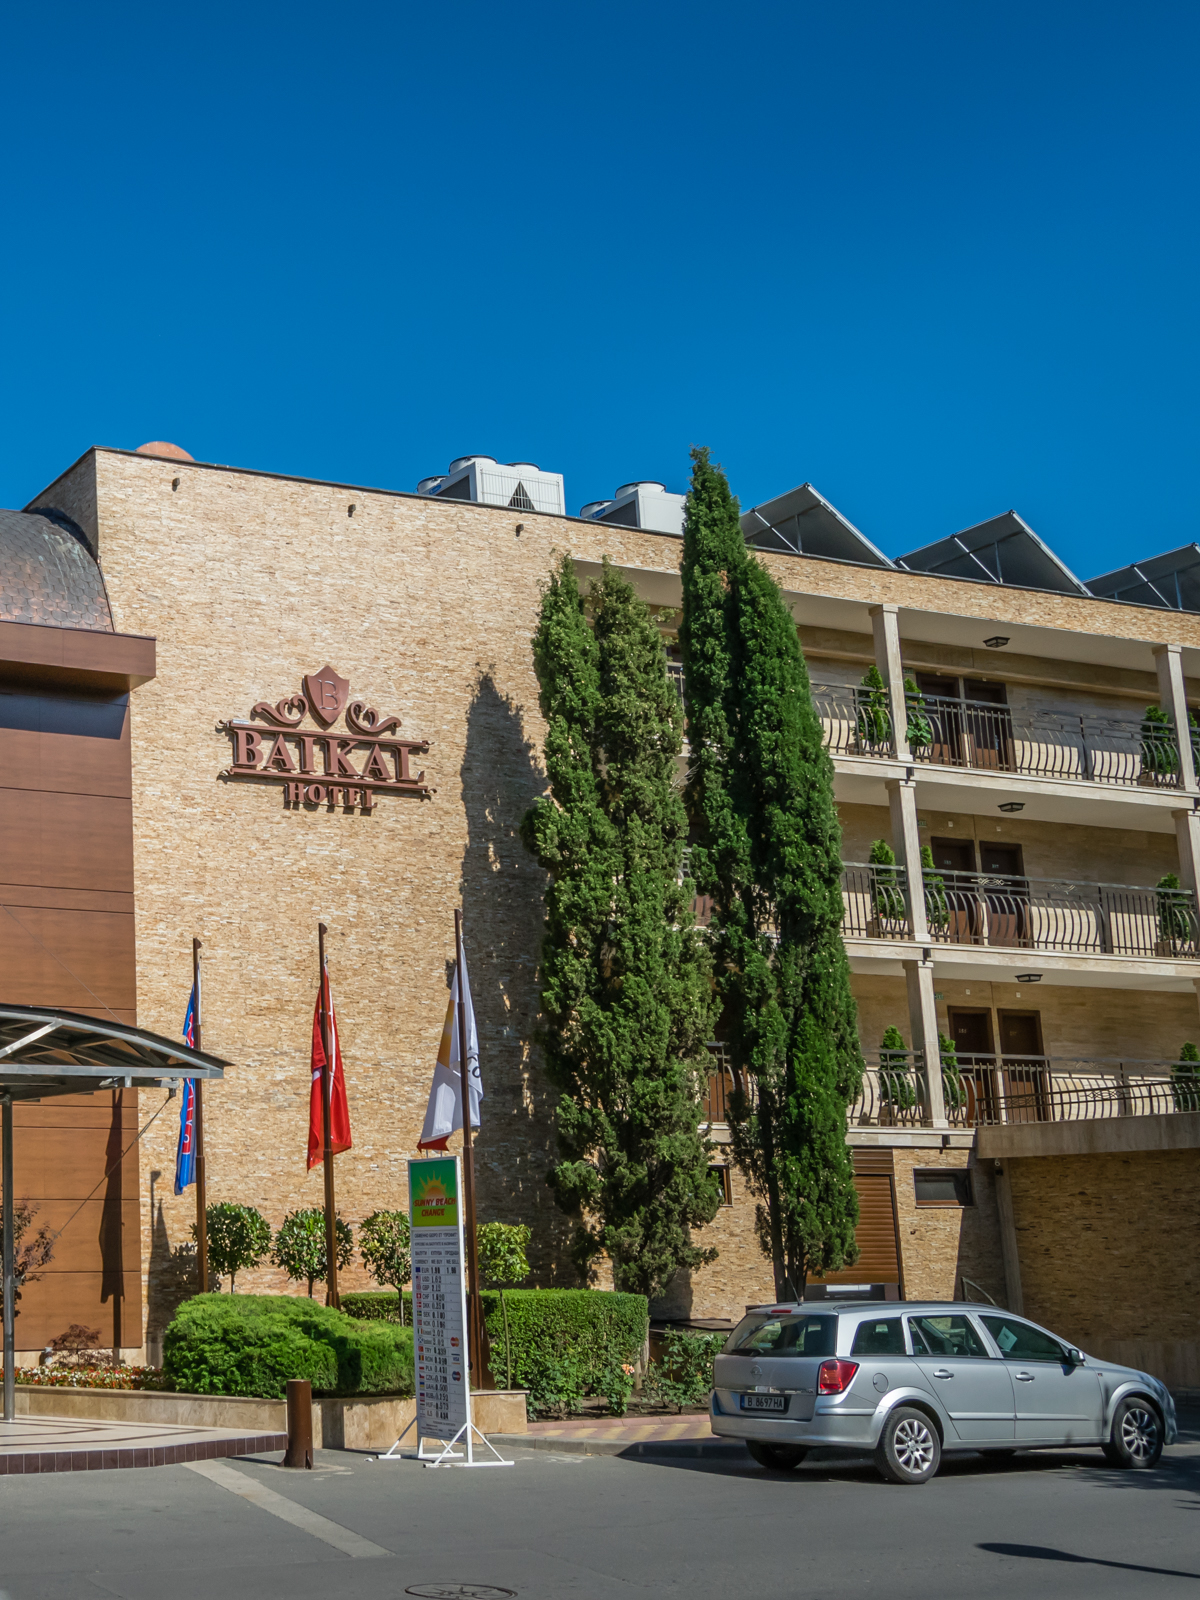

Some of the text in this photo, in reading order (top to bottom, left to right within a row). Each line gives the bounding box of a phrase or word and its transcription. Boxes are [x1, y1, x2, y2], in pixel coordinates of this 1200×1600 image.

[318, 679, 339, 710] B
[233, 729, 425, 784] BAIKAL
[286, 782, 378, 809] HOTEL
[413, 1197, 456, 1207] SUNNY BEACH
[421, 1208, 445, 1217] CHANGE
[747, 1396, 783, 1408] B 8697 HA
